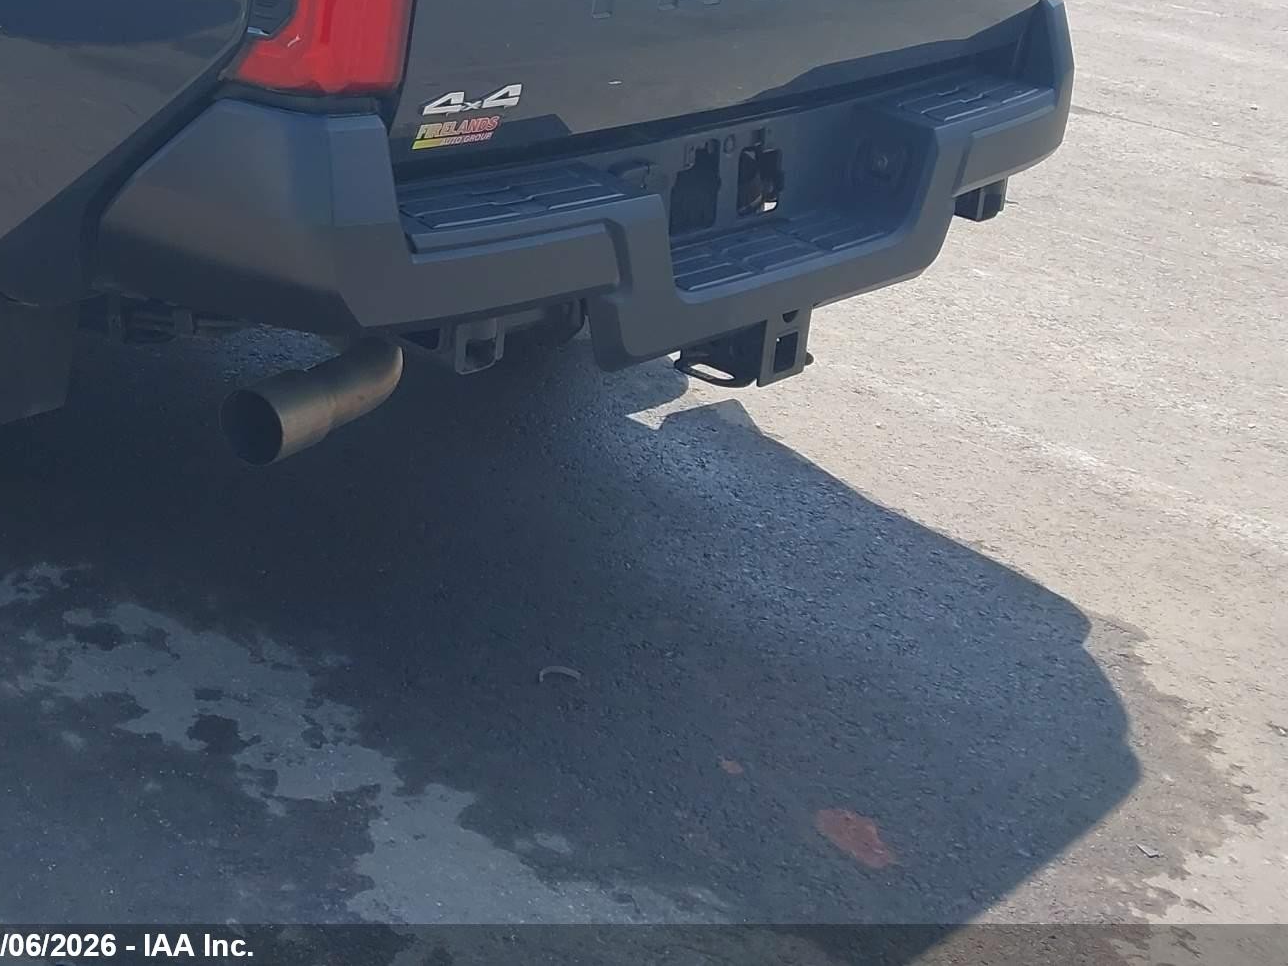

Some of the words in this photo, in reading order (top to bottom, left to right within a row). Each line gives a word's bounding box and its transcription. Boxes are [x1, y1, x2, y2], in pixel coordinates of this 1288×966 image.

[422, 84, 522, 115] 4x4
[415, 116, 500, 140] FIRELANDS
[440, 135, 462, 146] AUTO
[463, 132, 494, 144] GROUP
